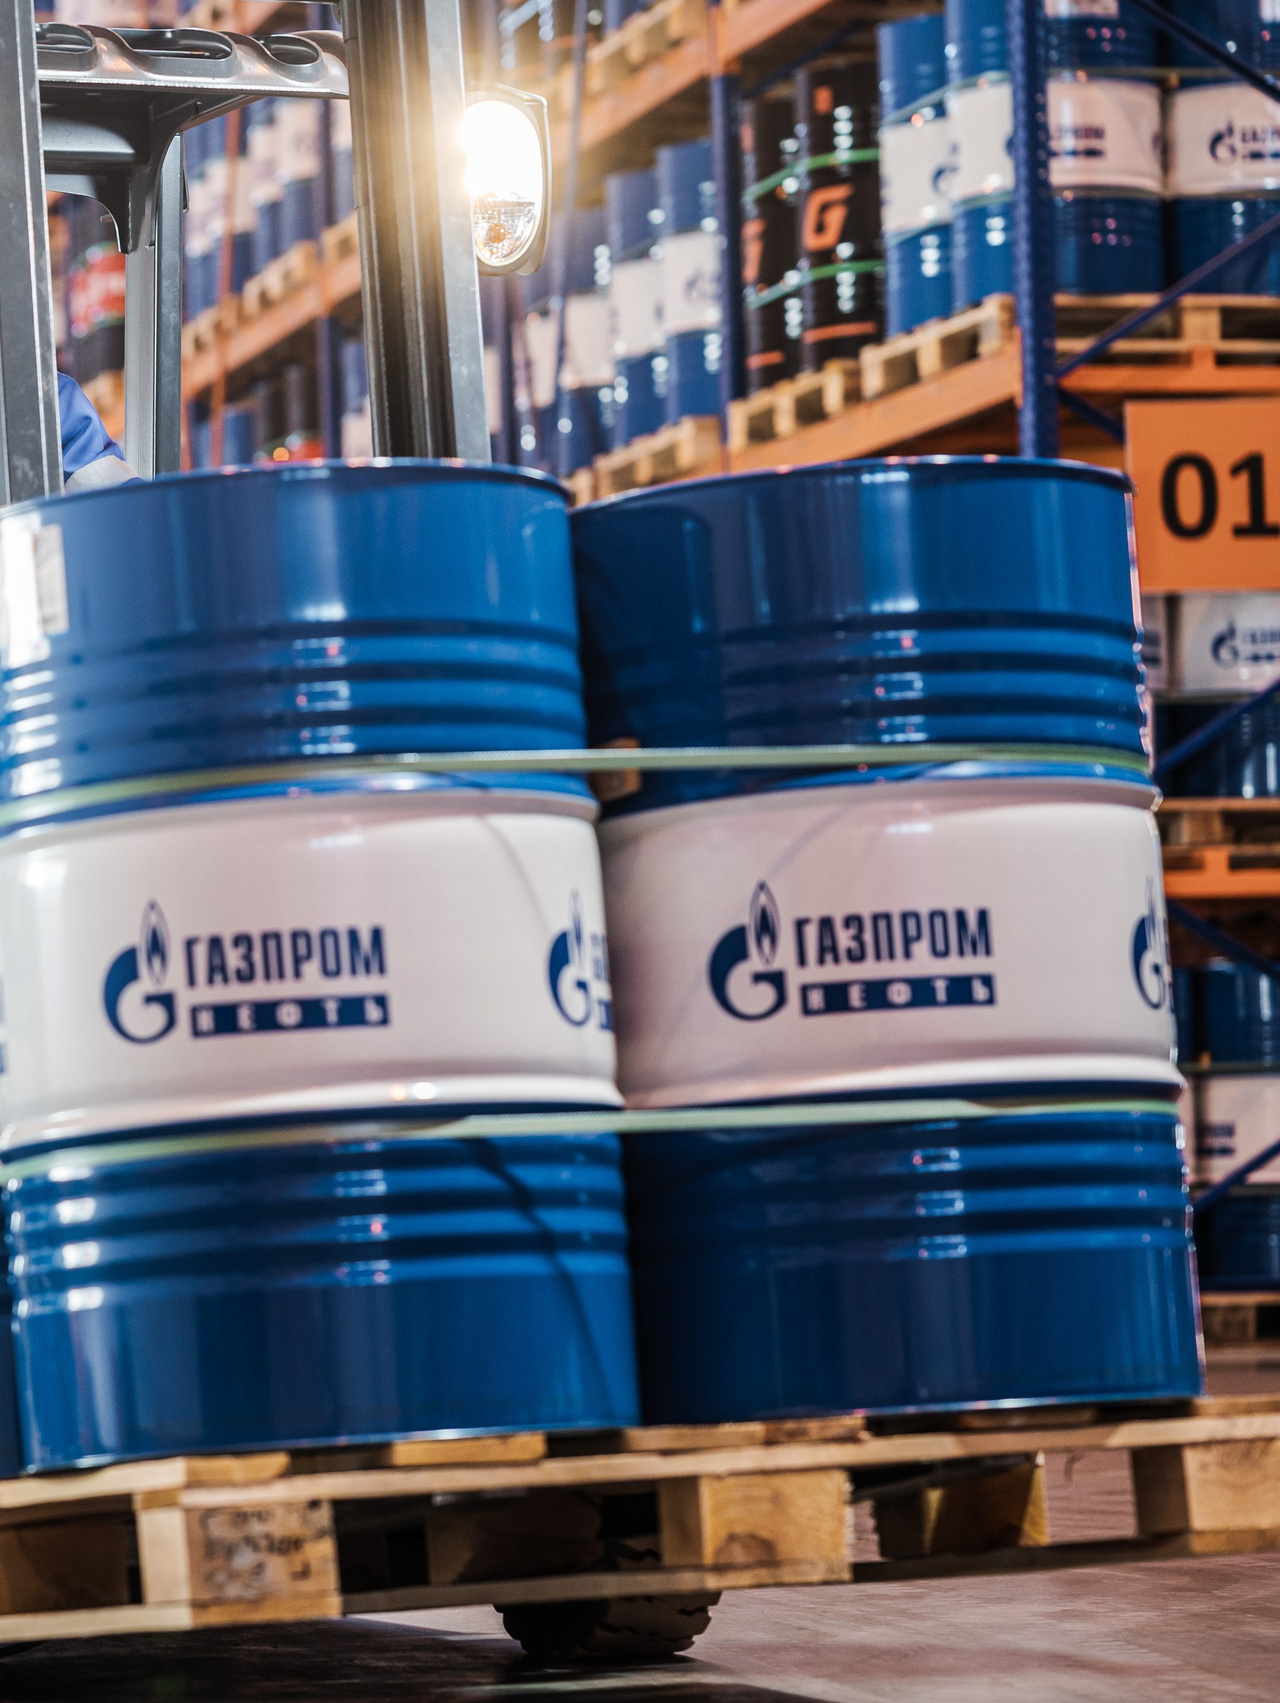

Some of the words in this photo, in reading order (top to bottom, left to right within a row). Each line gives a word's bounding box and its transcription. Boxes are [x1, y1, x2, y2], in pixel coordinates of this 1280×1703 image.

[1160, 452, 1280, 540] 01
[185, 926, 386, 988] ГАЗПРОМ
[793, 907, 992, 968] ГАЗПРОМ
[193, 998, 387, 1034] НЕФТЬ
[803, 977, 992, 1012] НЕФТЬ
